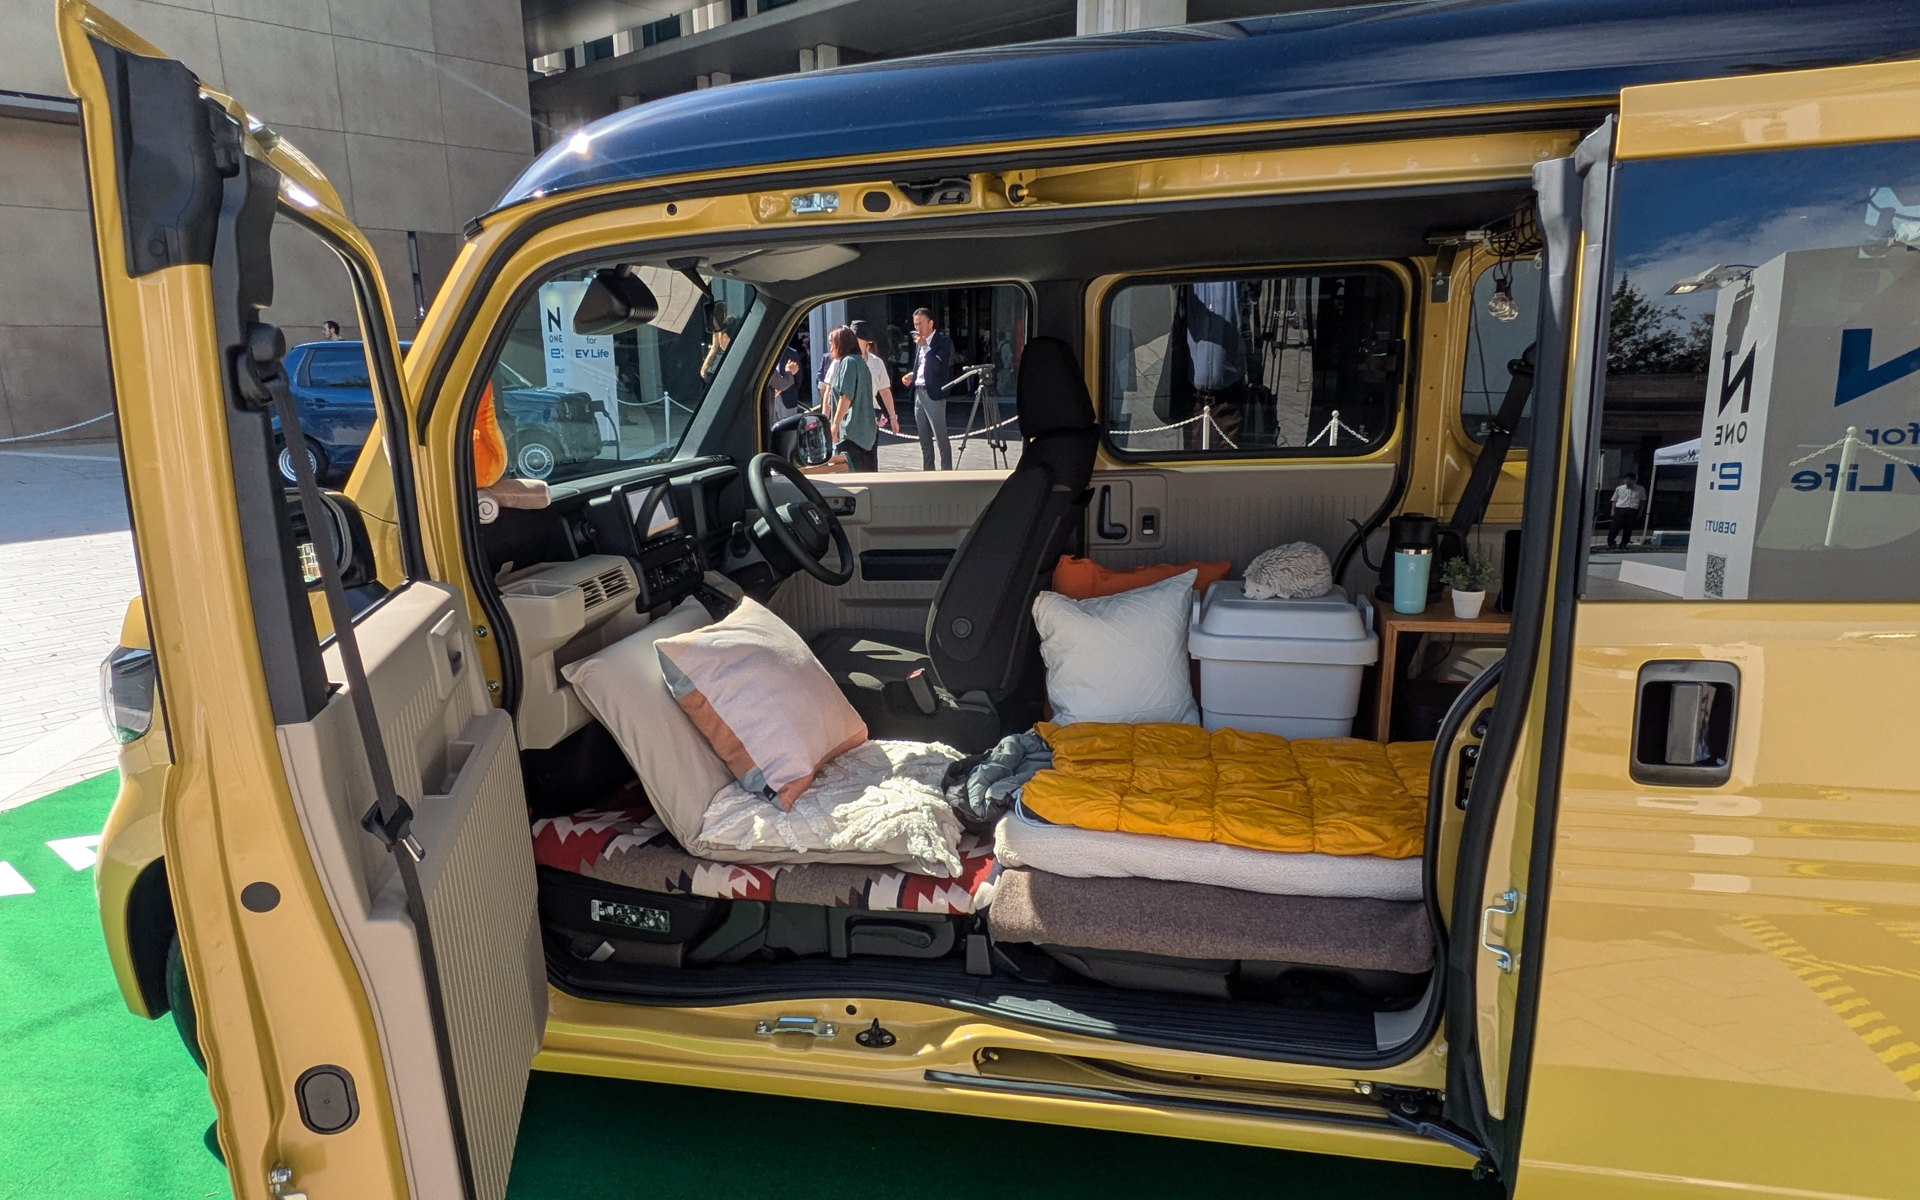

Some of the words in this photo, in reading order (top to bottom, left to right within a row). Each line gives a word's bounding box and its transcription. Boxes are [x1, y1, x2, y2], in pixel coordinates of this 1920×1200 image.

[547, 306, 562, 332] N
[549, 335, 563, 343] ONE
[586, 336, 597, 344] for
[575, 349, 589, 358] EV
[591, 349, 609, 358] Life
